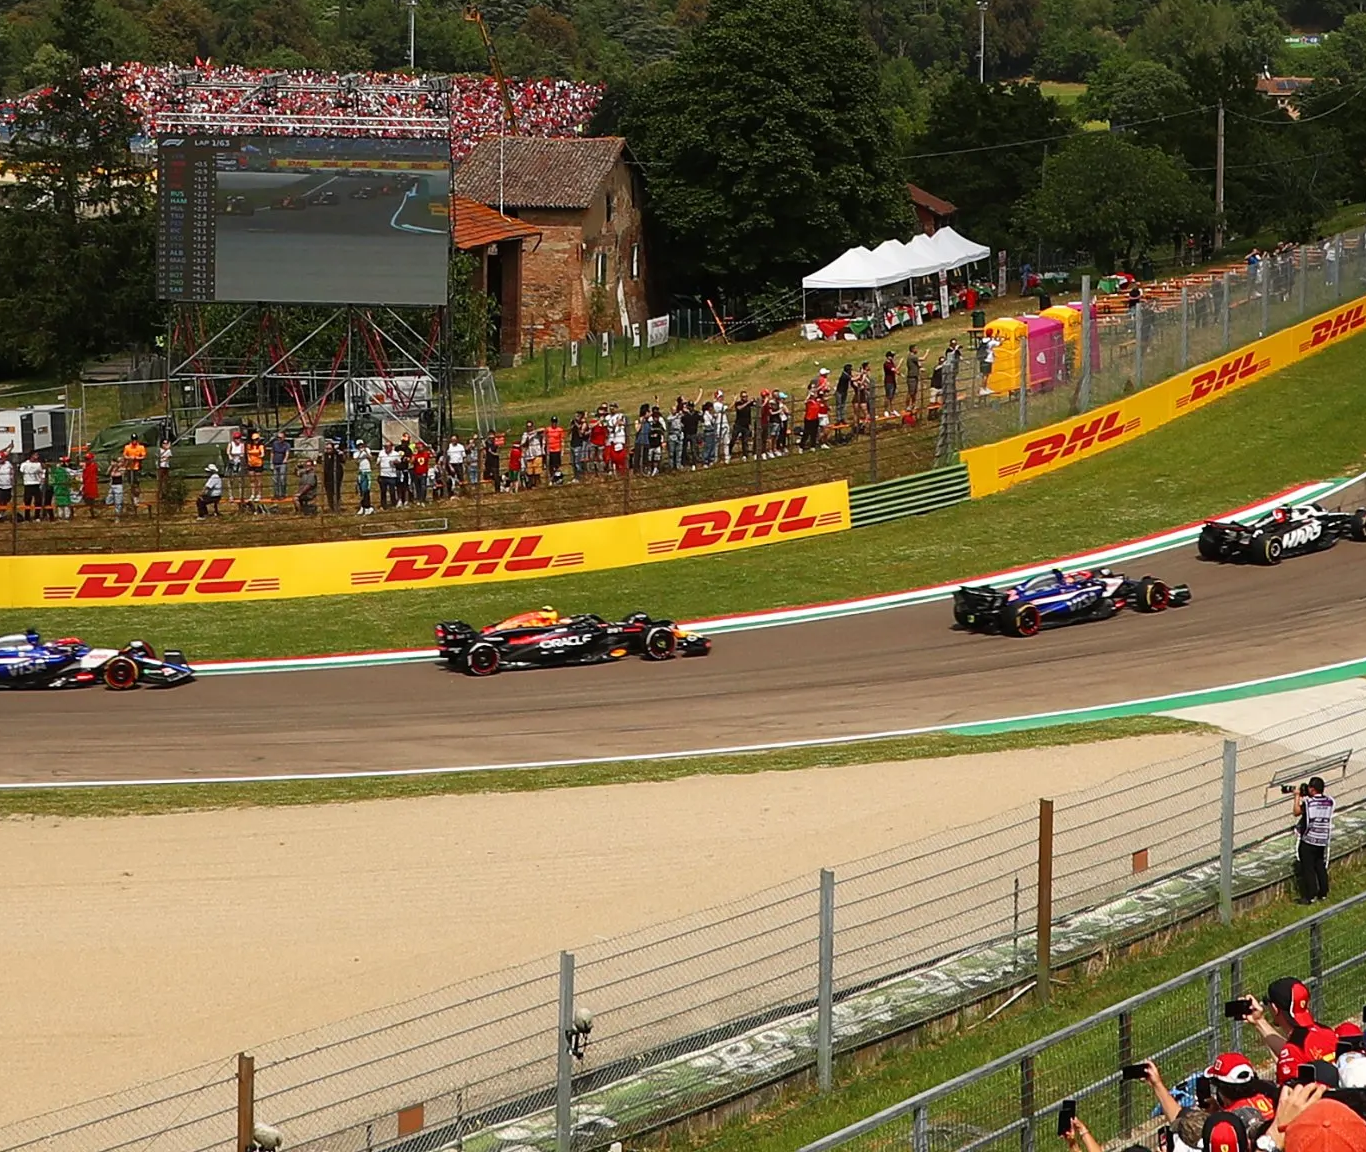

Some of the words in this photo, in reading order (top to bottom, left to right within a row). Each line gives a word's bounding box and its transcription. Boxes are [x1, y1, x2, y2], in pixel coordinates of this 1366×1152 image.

[194, 139, 210, 147] LAP
[1310, 304, 1366, 347] DHL
[1189, 351, 1261, 402] DHL
[1021, 410, 1127, 471] DHL
[677, 496, 817, 550] DHL
[1282, 519, 1322, 549] HAAS
[75, 558, 246, 599] DHL
[383, 535, 553, 583] DHL
[538, 634, 592, 649] ORACLE
